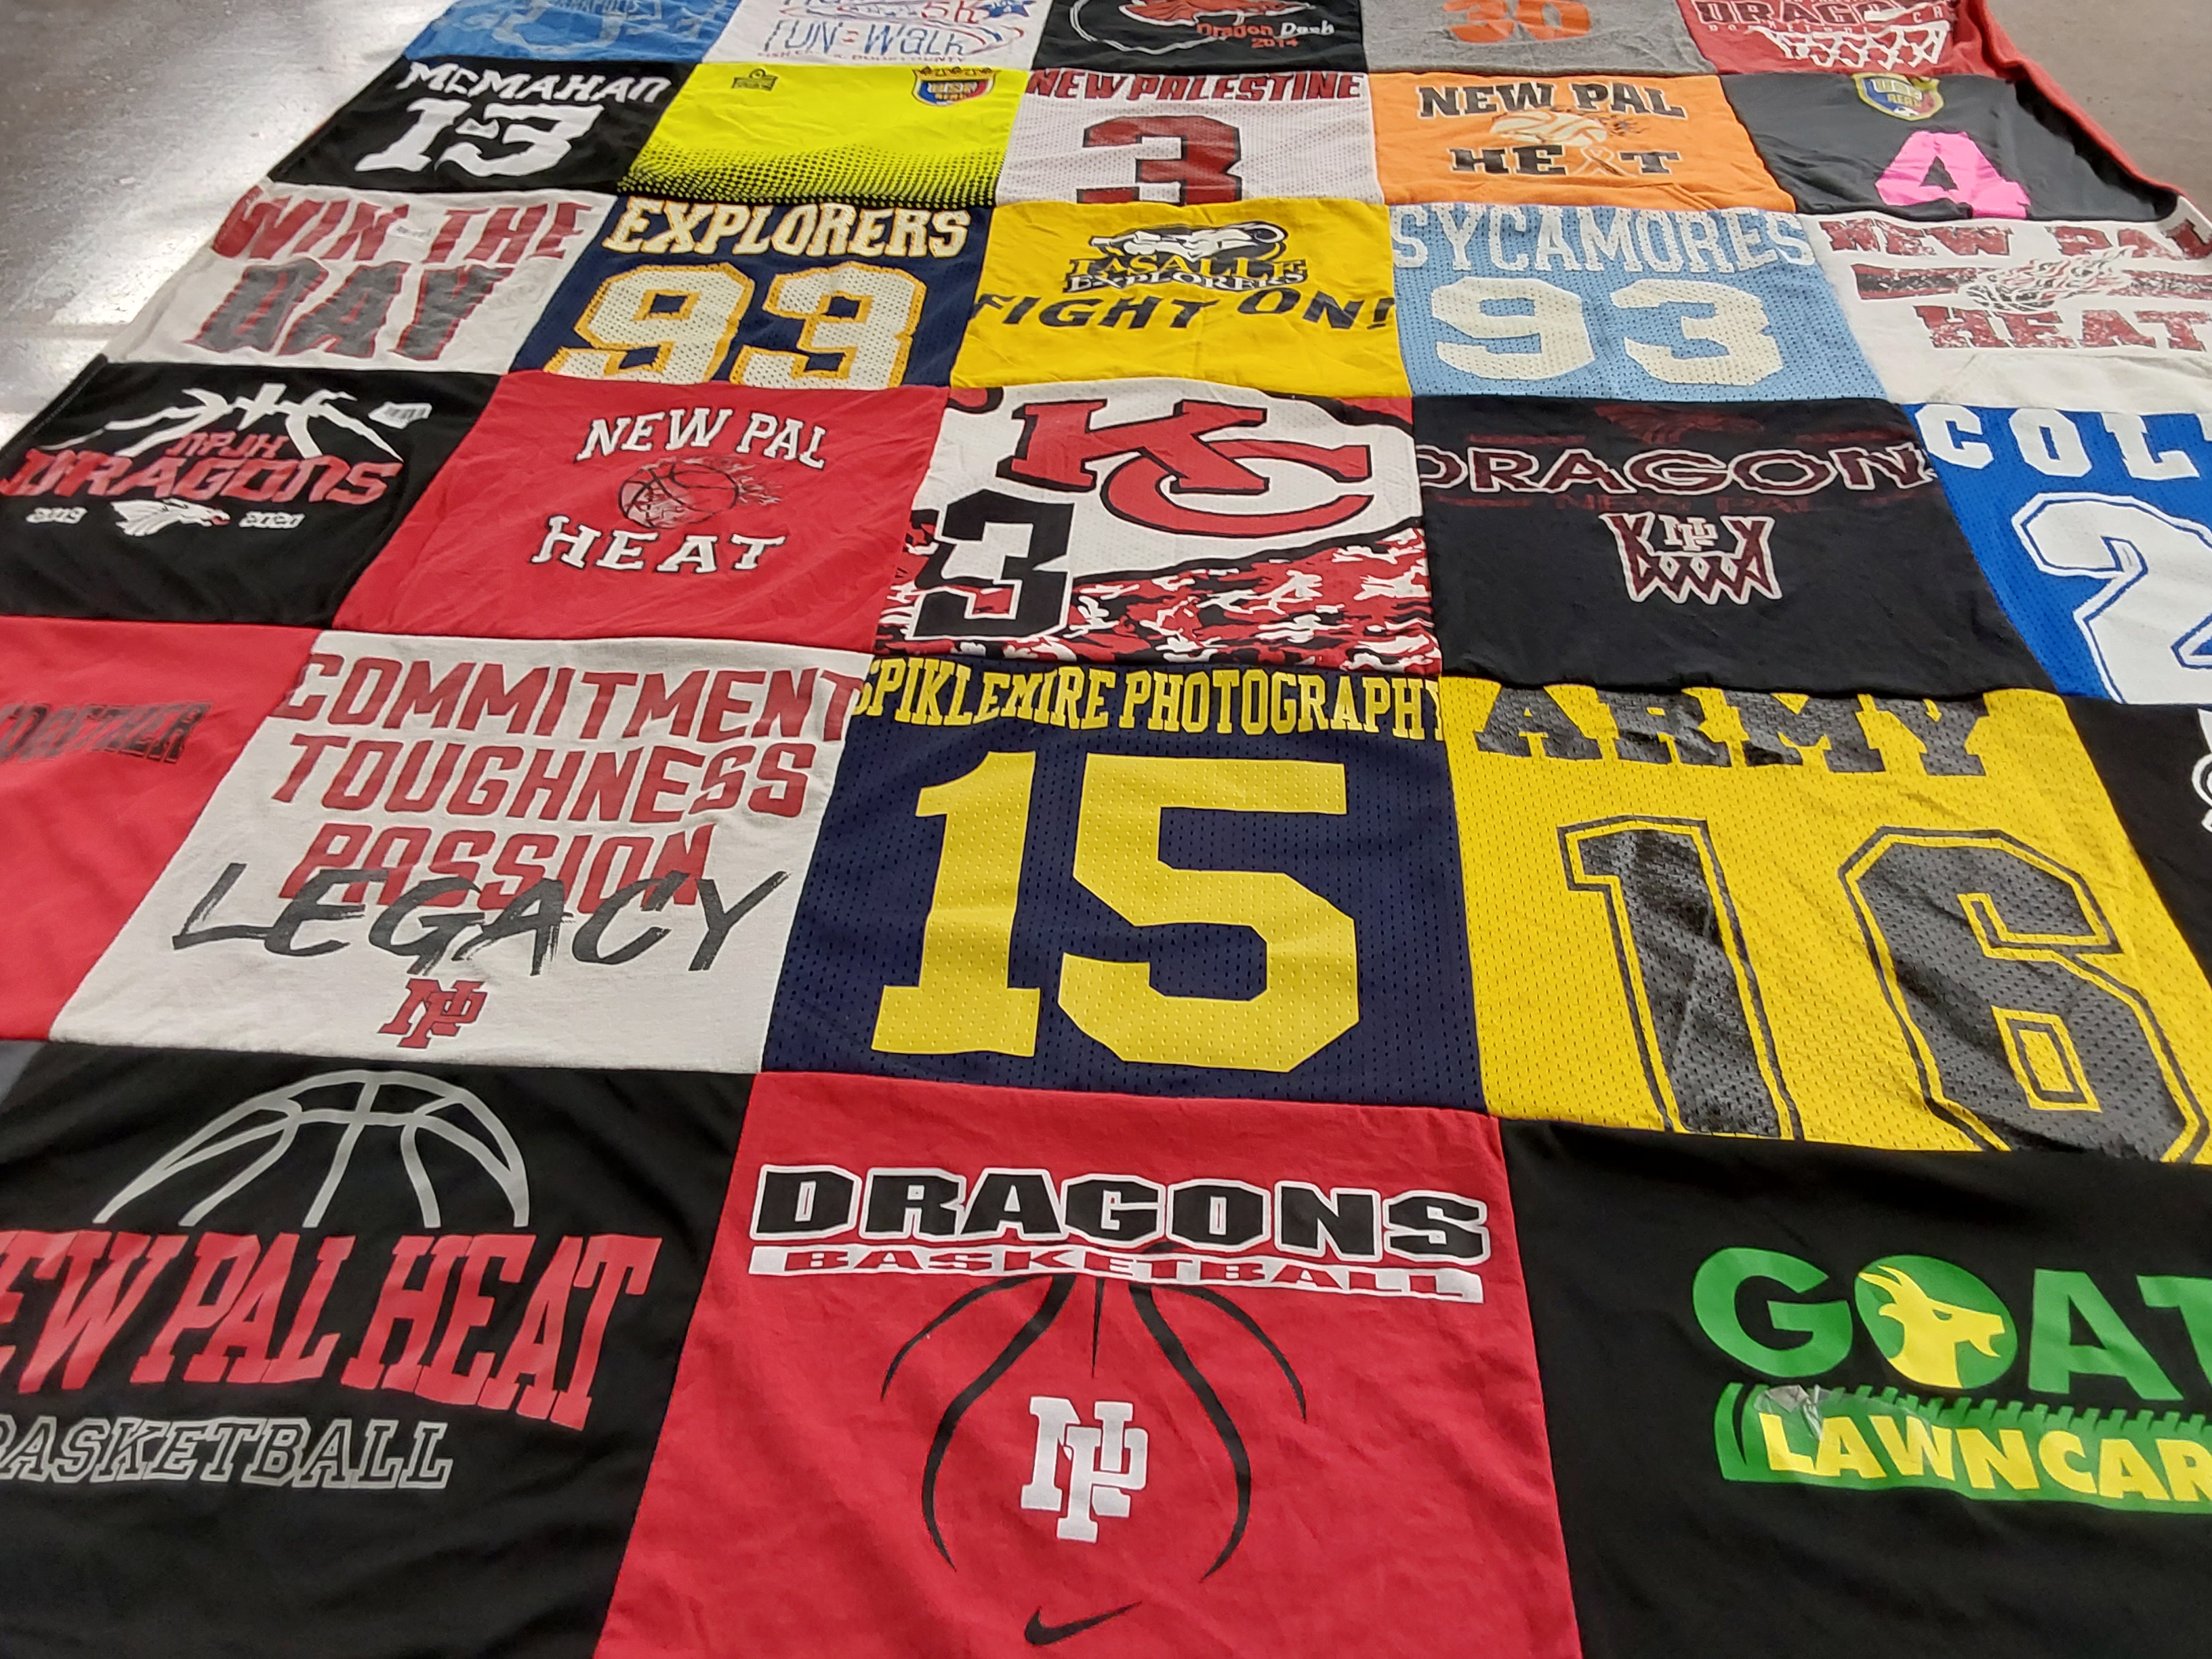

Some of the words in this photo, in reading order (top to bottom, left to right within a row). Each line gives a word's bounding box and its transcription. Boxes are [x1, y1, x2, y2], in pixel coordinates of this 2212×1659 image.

[1197, 22, 1274, 39] Dragon
[1251, 37, 1300, 49] 2014
[1025, 69, 1124, 99] NEW
[1125, 73, 1369, 102] PALESTINE
[1417, 81, 1556, 119] NEW
[1570, 82, 1687, 120] PAL
[354, 98, 605, 176] 13
[1076, 115, 1243, 205] 3
[213, 185, 410, 262] WIN
[423, 201, 592, 264] THE
[602, 195, 972, 258] EXPLORERS
[1391, 205, 1818, 274] SYCAMORES
[1819, 218, 2013, 255] NEW
[182, 257, 515, 361] DAY
[544, 261, 927, 390] 93
[966, 292, 1220, 330] FIGHT
[1235, 287, 1397, 331] ON!
[1431, 276, 1786, 386] 93
[1912, 304, 2212, 350] HEAT
[0, 447, 405, 505] DRAGONS
[573, 407, 733, 464] NEW
[735, 411, 827, 471] PAL
[1414, 442, 1940, 496] DRAGON
[1914, 403, 2212, 481] COL
[529, 514, 788, 575] HEAT
[907, 489, 1076, 641] 3
[266, 651, 865, 743] COMMITMENT
[1475, 684, 1988, 777] ARMY
[270, 733, 817, 824] TOUGHNESS
[279, 822, 714, 915] PASSION
[172, 862, 790, 976] LEGACY
[872, 750, 1359, 1072] 15
[1556, 815, 2212, 1166] 16
[750, 1164, 1491, 1263] DRAGONS
[784, 1249, 1467, 1297] BASKETBALL
[0, 1229, 190, 1395] EW
[130, 1232, 356, 1384] PAL
[341, 1233, 663, 1431] HEAT
[1692, 1247, 2212, 1401] GOAT
